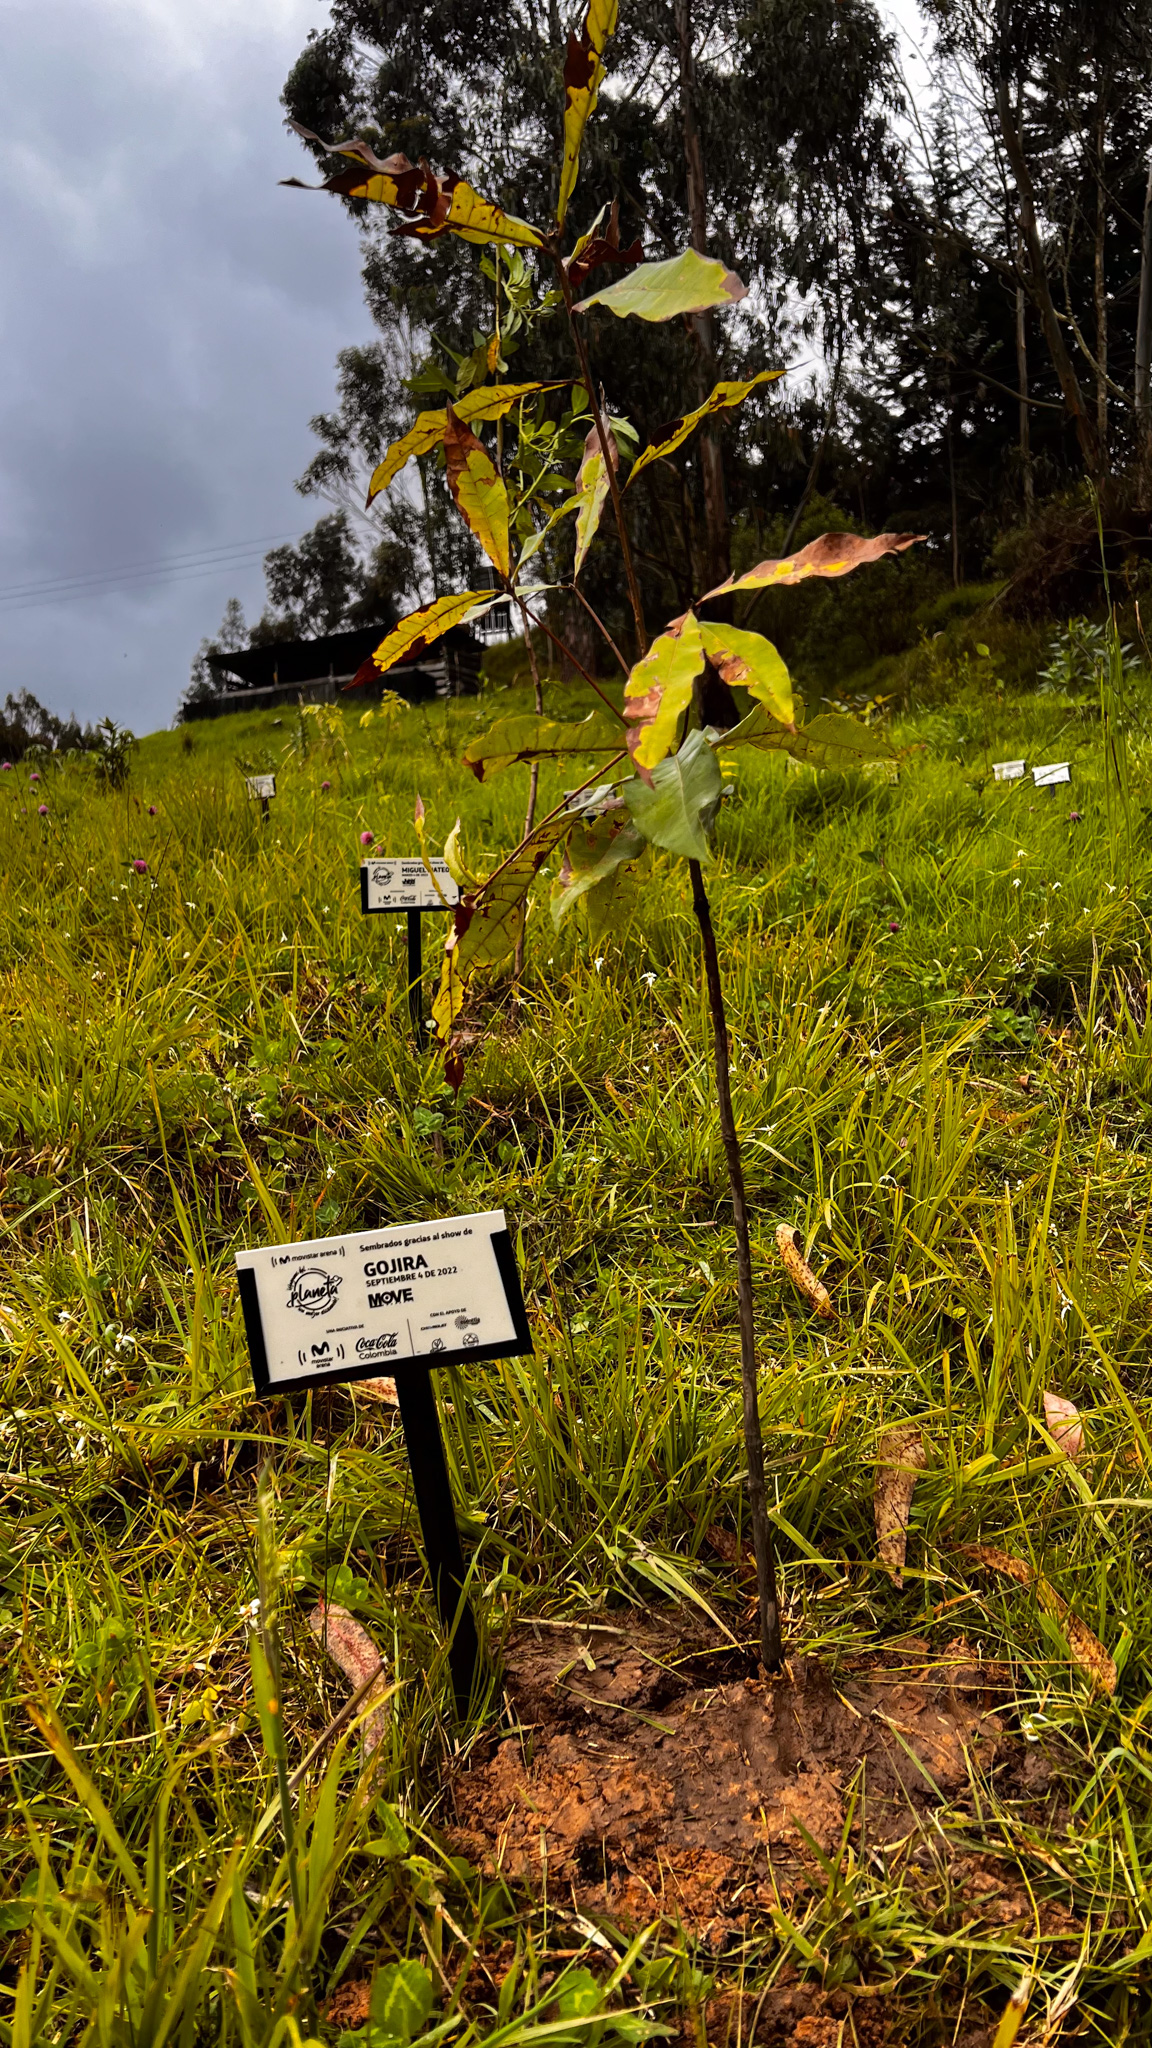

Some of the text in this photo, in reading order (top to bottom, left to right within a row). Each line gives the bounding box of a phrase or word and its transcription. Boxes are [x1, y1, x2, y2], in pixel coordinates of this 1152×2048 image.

[359, 1228, 473, 1252] Sembrados gracias al show de
[292, 1249, 338, 1262] movistar arena
[363, 1254, 429, 1277] GOJIRA
[366, 1266, 458, 1288] SEPTIEMBRE 4 DE 2022
[291, 1275, 338, 1307] planeta
[368, 1287, 414, 1309] MOVE
[355, 1332, 399, 1353] Coca-Cola
[311, 1356, 334, 1365] movistar
[358, 1348, 398, 1361] Colombia
